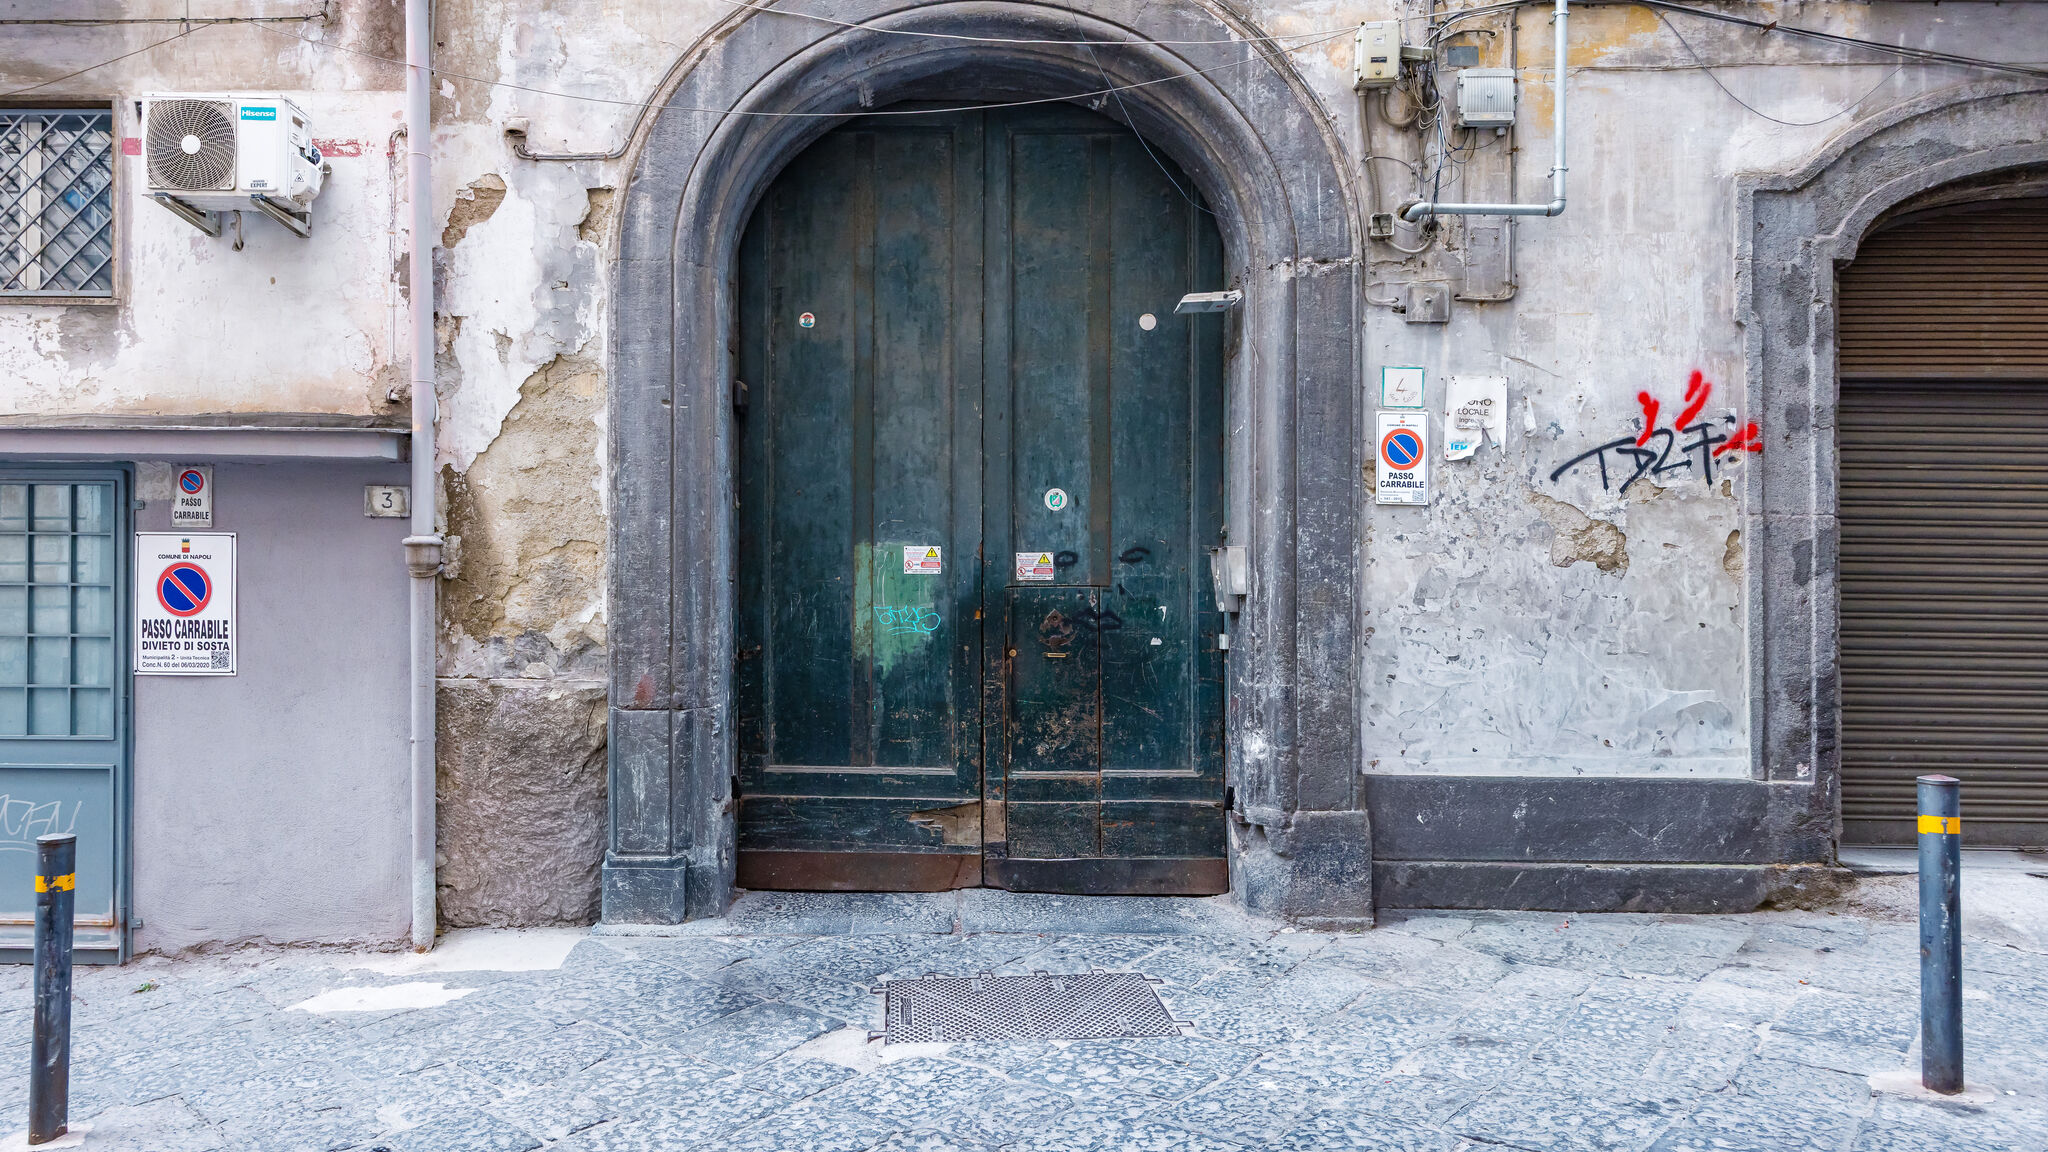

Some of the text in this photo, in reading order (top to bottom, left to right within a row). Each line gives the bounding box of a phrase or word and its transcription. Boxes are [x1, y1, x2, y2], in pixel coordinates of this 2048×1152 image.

[241, 109, 275, 117] Hisense
[1457, 408, 1490, 416] LOCALE
[1388, 472, 1414, 480] PASSO
[1380, 480, 1425, 488] CARRABILE
[181, 497, 202, 506] PASSO
[381, 492, 393, 509] 3
[174, 511, 209, 520] CARRABILE
[141, 619, 229, 640] PASSO CARRABILE
[142, 641, 230, 651] DIVIETO DI SOSTA
